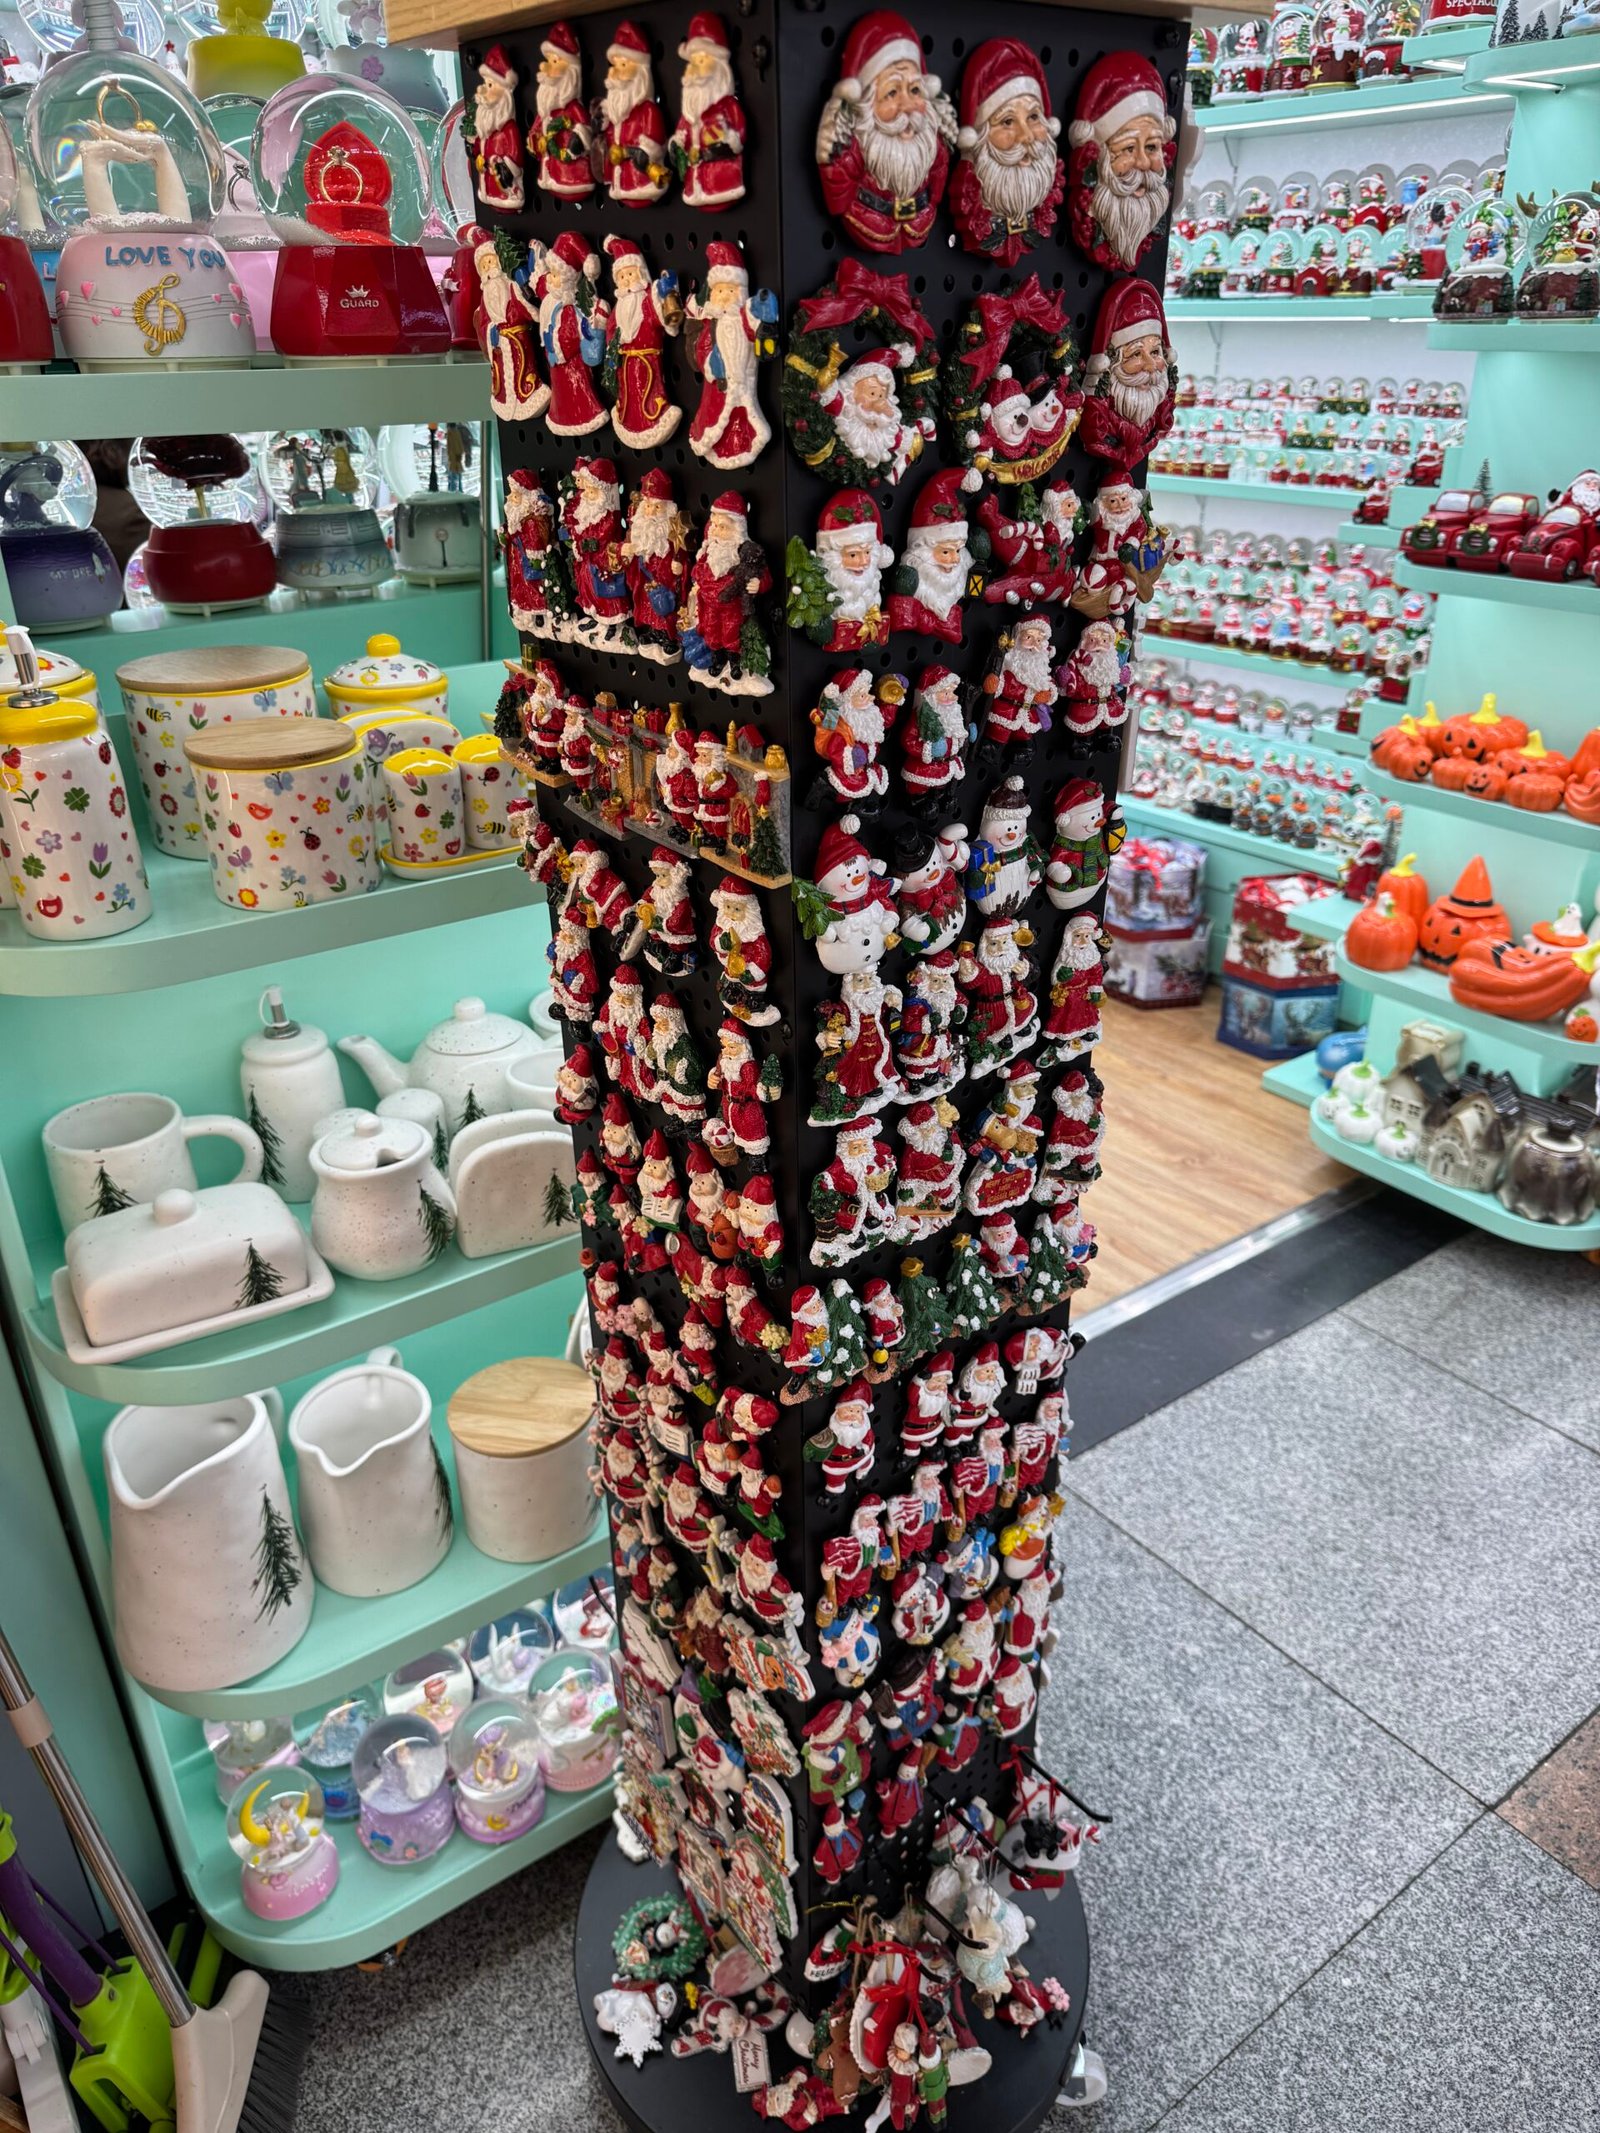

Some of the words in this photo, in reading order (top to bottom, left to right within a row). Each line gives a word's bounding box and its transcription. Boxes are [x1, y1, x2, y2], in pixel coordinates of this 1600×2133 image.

[105, 246, 172, 267] LOVE
[178, 247, 227, 271] YOU
[340, 298, 380, 309] GUARD
[738, 2039, 750, 2084] Christmas
[750, 2041, 762, 2070] Merry
